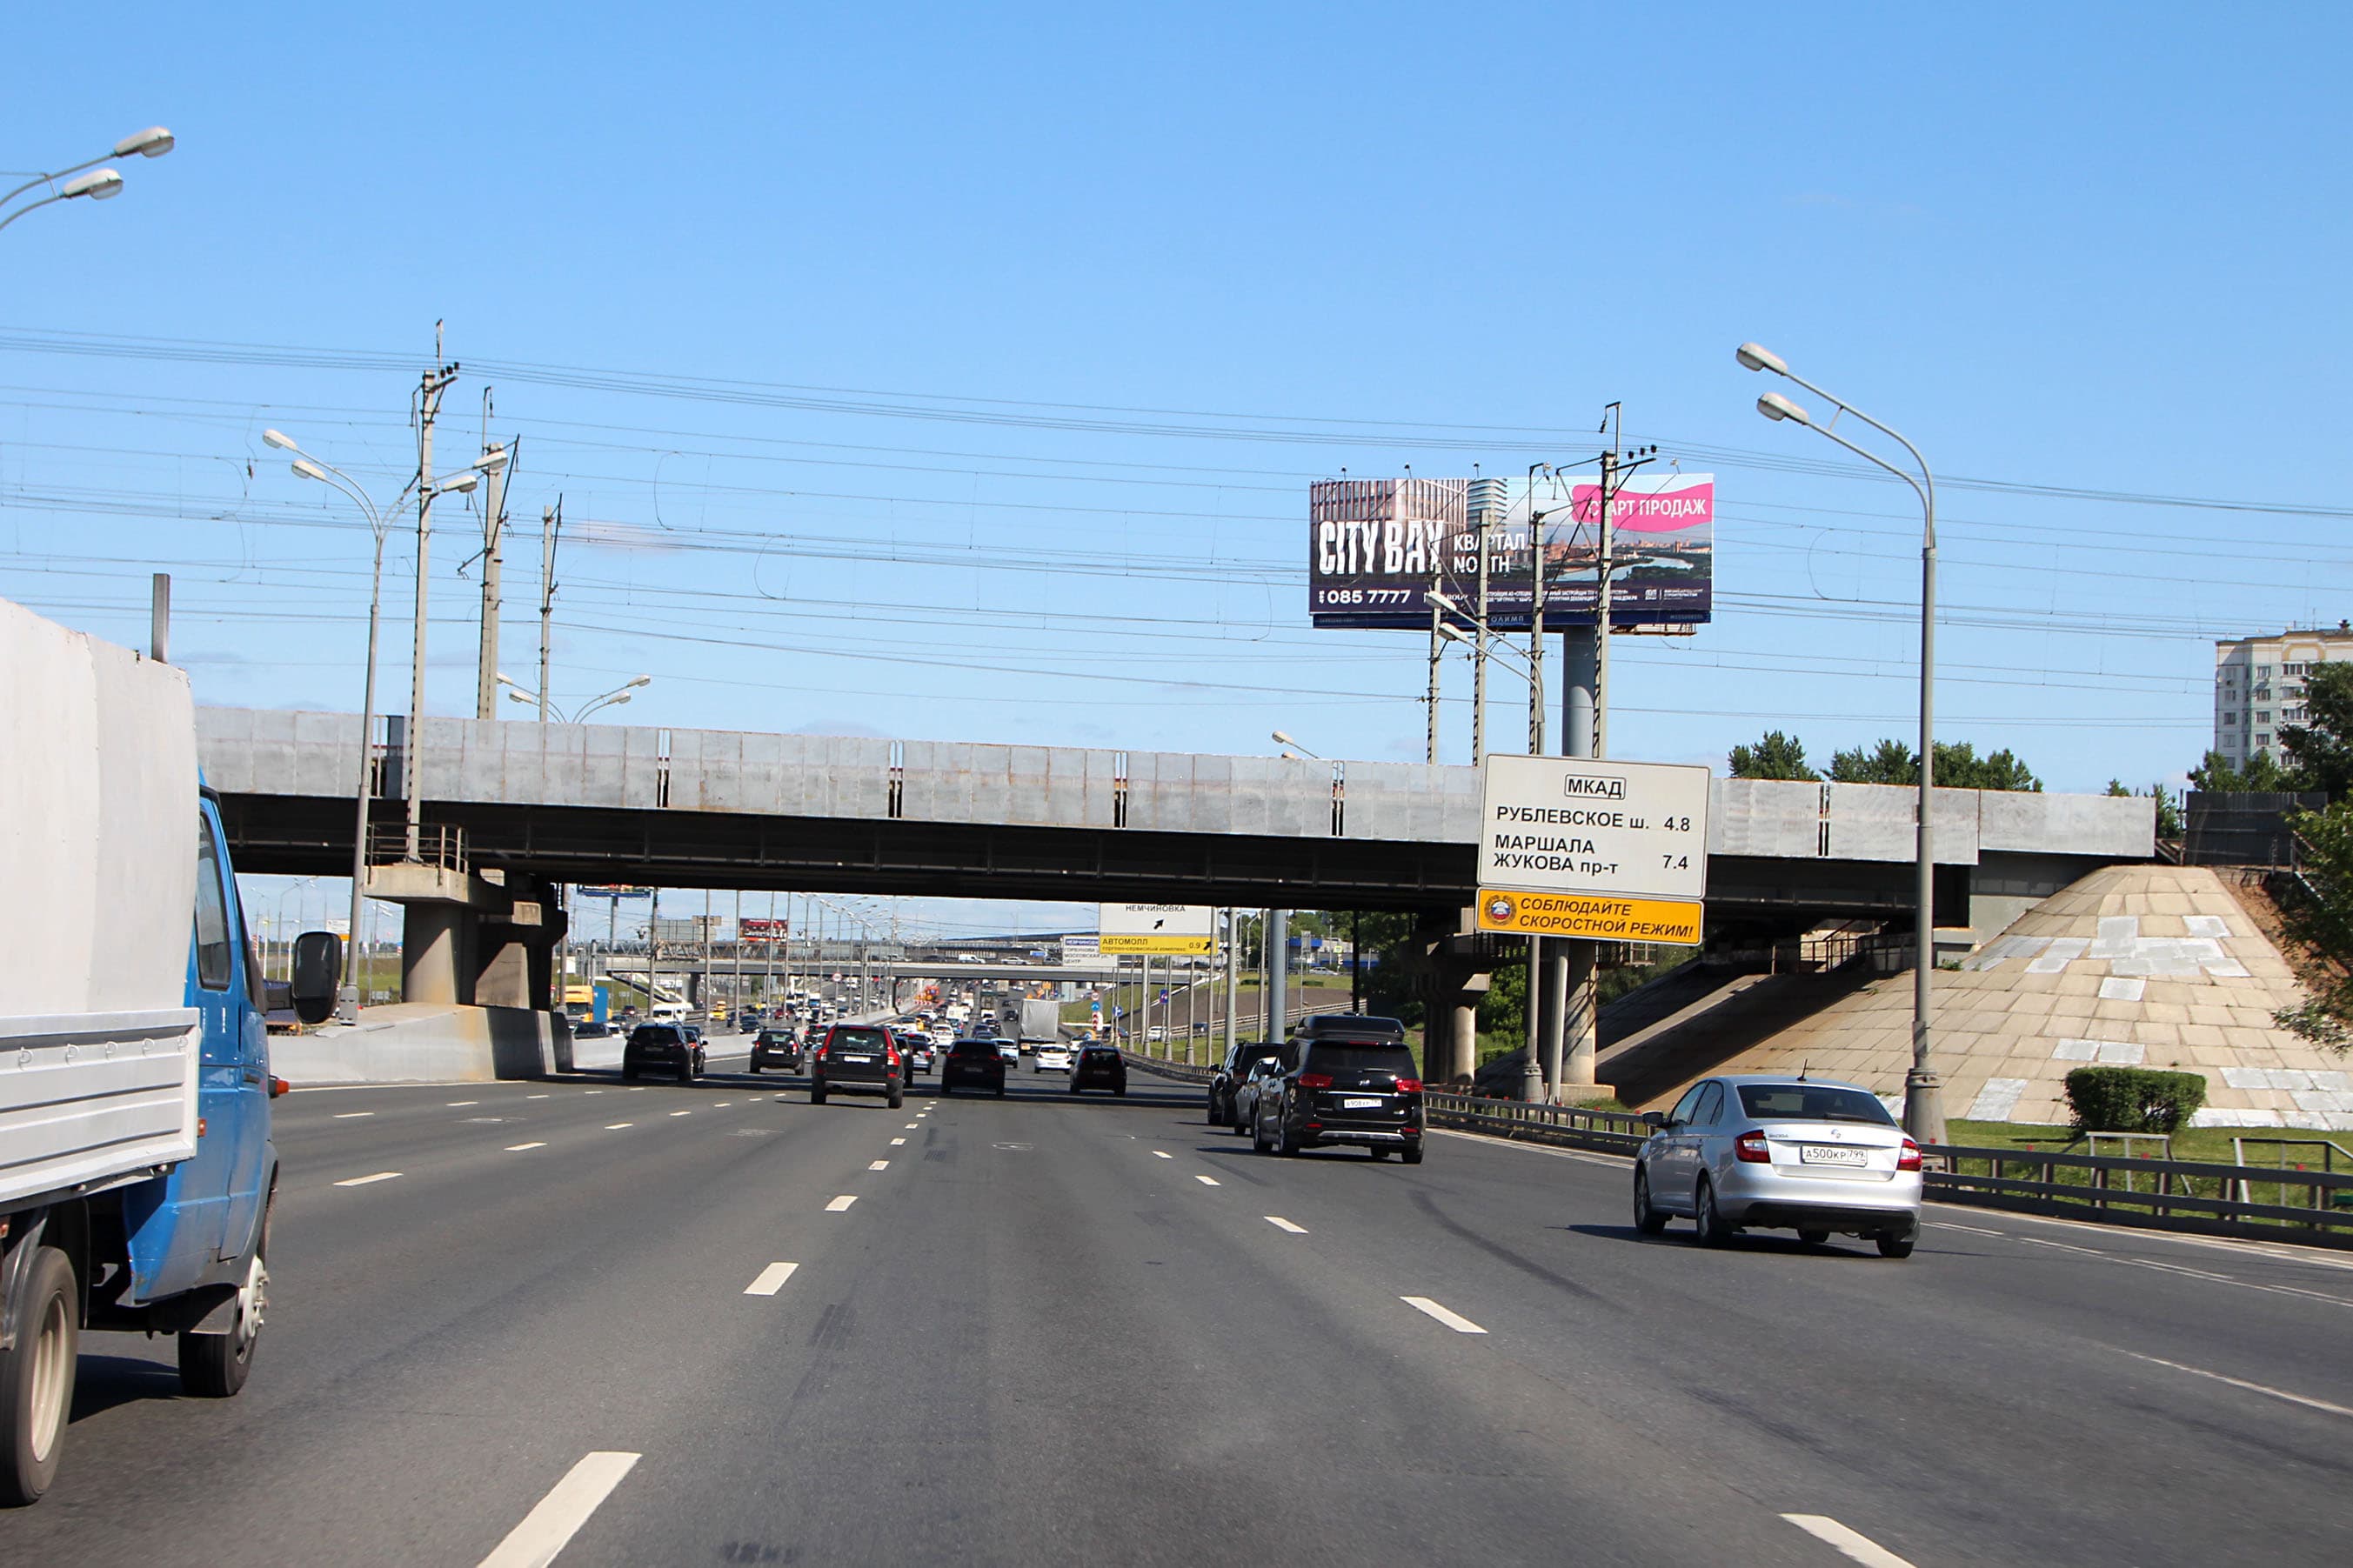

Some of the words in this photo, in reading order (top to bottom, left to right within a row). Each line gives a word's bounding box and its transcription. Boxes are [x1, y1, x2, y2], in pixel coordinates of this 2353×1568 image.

[1588, 500, 1635, 517] САРТ
[1639, 499, 1706, 518] ПРОДАЖ
[1319, 521, 1379, 575] CITY
[1384, 520, 1444, 575] BAY
[1454, 556, 1510, 573] NOTH
[1327, 590, 1363, 604] 085
[1367, 590, 1411, 604] 7777
[1568, 778, 1622, 799] МКАД
[1496, 806, 1624, 828] РУБЛЕВСКОЕ
[1629, 817, 1649, 830] ш.
[1663, 816, 1690, 832] 4.8
[1494, 834, 1595, 854] МАРШАЛА
[1493, 853, 1574, 871] ЖУКОВА
[1580, 860, 1619, 877] пр-т
[1662, 855, 1688, 870] 7.4
[1521, 897, 1633, 917] СОБЛЮДАЙТЕ
[1520, 914, 1626, 933] СКОРОСТНОЙ
[1629, 922, 1694, 937] РЕЖИМ!
[1806, 1148, 1846, 1159] А500КР
